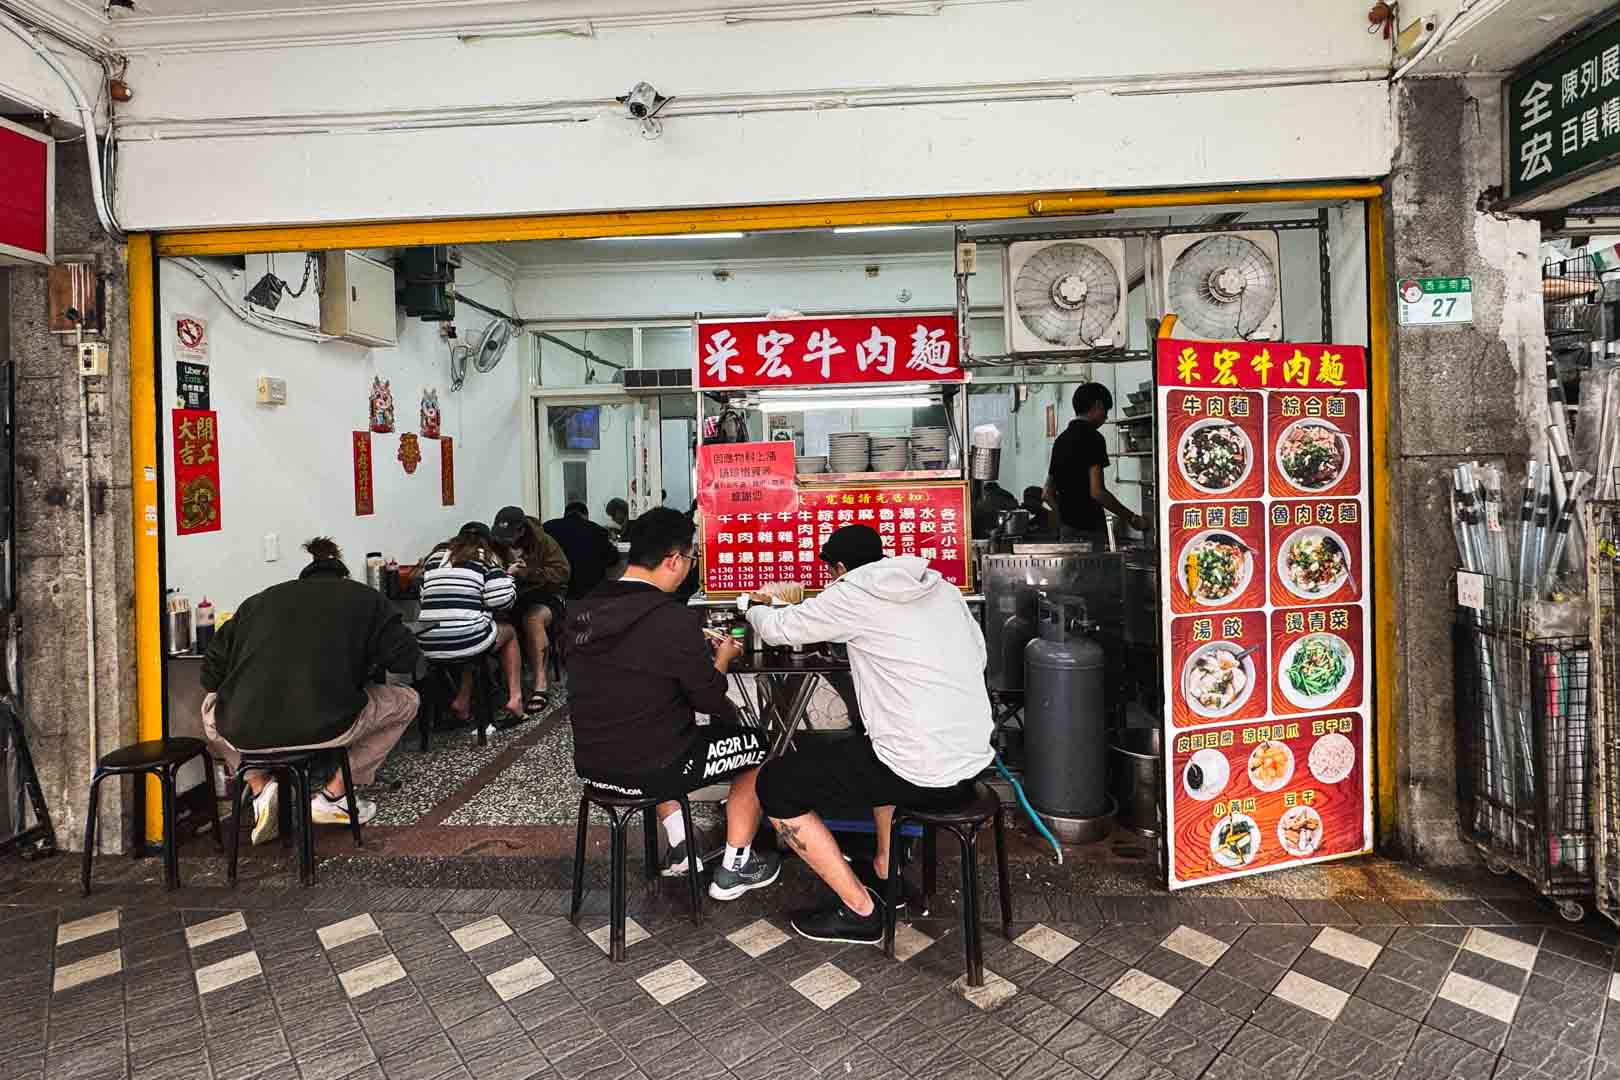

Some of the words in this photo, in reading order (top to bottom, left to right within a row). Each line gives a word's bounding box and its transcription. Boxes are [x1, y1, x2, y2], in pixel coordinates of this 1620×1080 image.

[1519, 80, 1553, 182] 全宏
[1432, 297, 1457, 318] 27
[704, 324, 958, 382] 采宏牛肉麵
[1177, 347, 1348, 386] 采宏牛肉麵
[1184, 397, 1249, 416] 牛肉麵
[1281, 397, 1345, 416] 綜合麵
[1183, 507, 1249, 528] 麻醬麵
[1272, 504, 1357, 524] 魯肉乾麵
[940, 508, 958, 560] 各式小菜
[758, 572, 775, 580] 120
[779, 572, 795, 580] 120
[1194, 618, 1242, 640] 湯餃
[1286, 610, 1348, 632] 燙青菜
[707, 736, 741, 761] AG2R
[744, 733, 759, 750] LA
[1177, 730, 1234, 752] 皮蛋豆腐
[703, 750, 766, 779] MONDIALE
[592, 781, 643, 796] DECATHLON
[1283, 790, 1315, 807] 豆干
[1213, 799, 1256, 816] 小黃瓜
